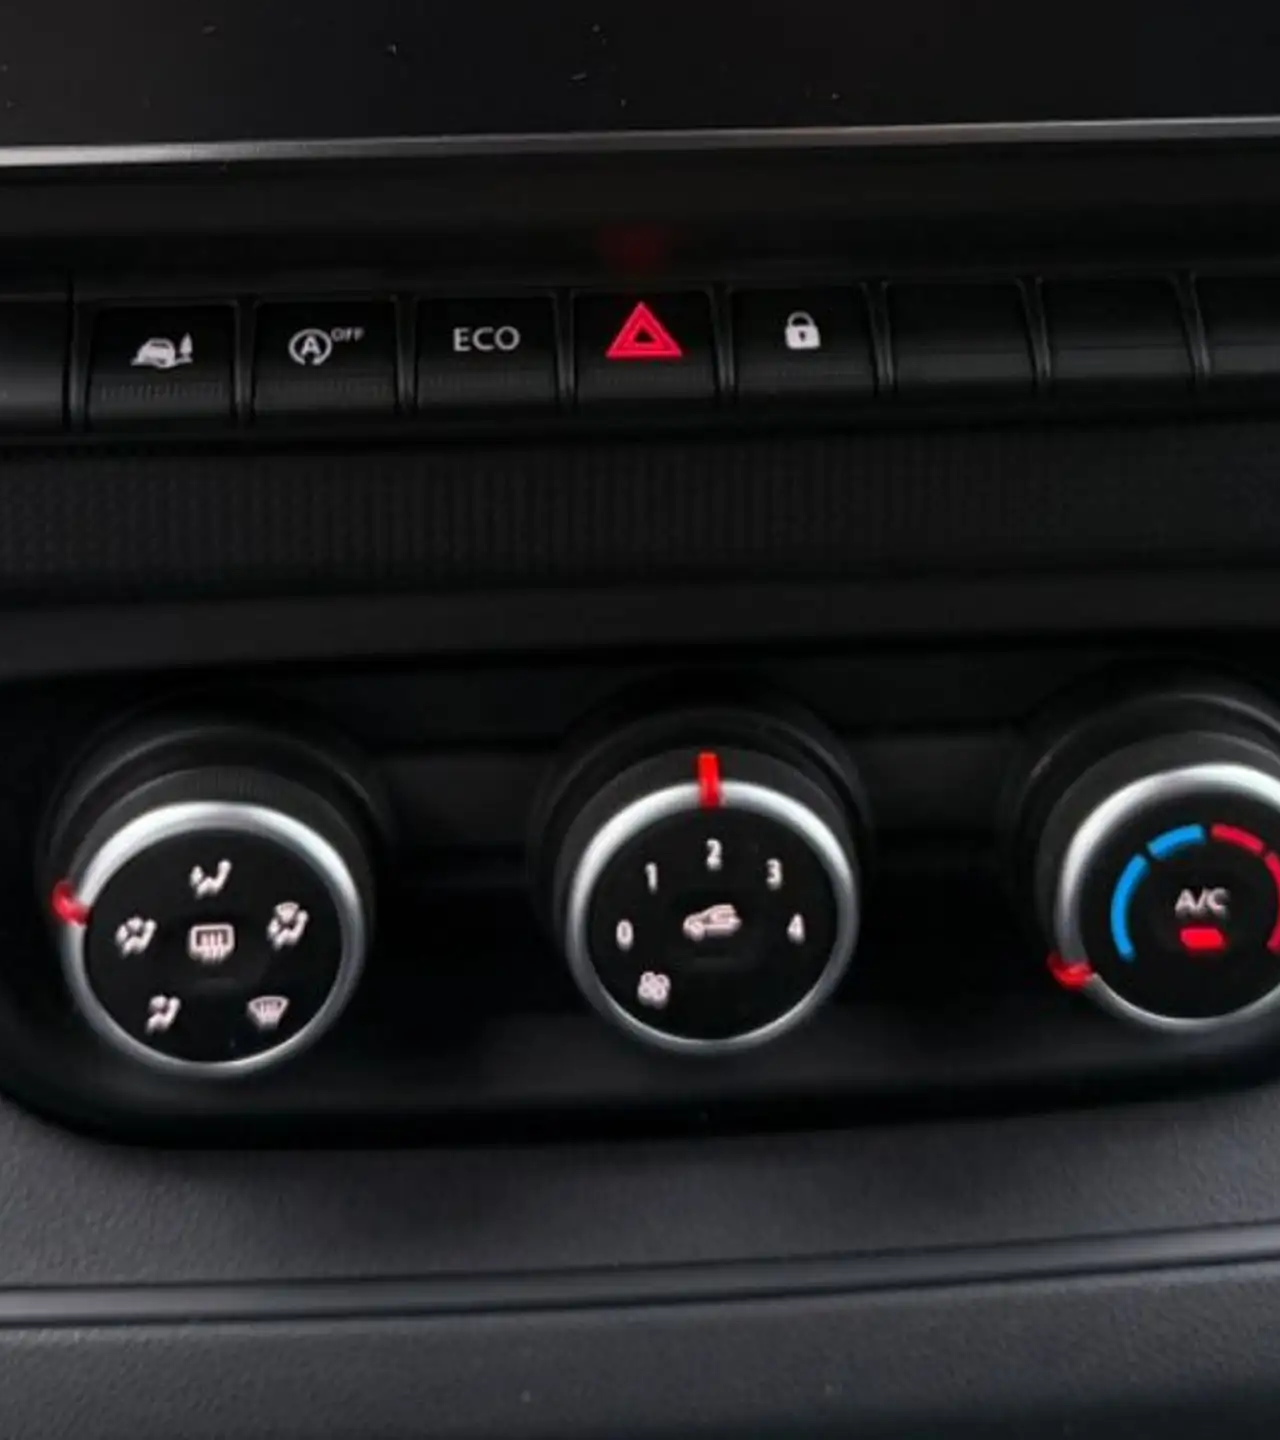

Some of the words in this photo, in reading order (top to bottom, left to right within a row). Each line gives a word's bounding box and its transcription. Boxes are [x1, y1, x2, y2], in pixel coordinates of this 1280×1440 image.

[453, 326, 520, 352] ECO
[705, 838, 723, 871] 2
[645, 862, 658, 894] 1
[766, 859, 783, 890] 3
[1174, 887, 1228, 917] A/C
[616, 918, 634, 951] 0
[787, 913, 806, 944] 4
